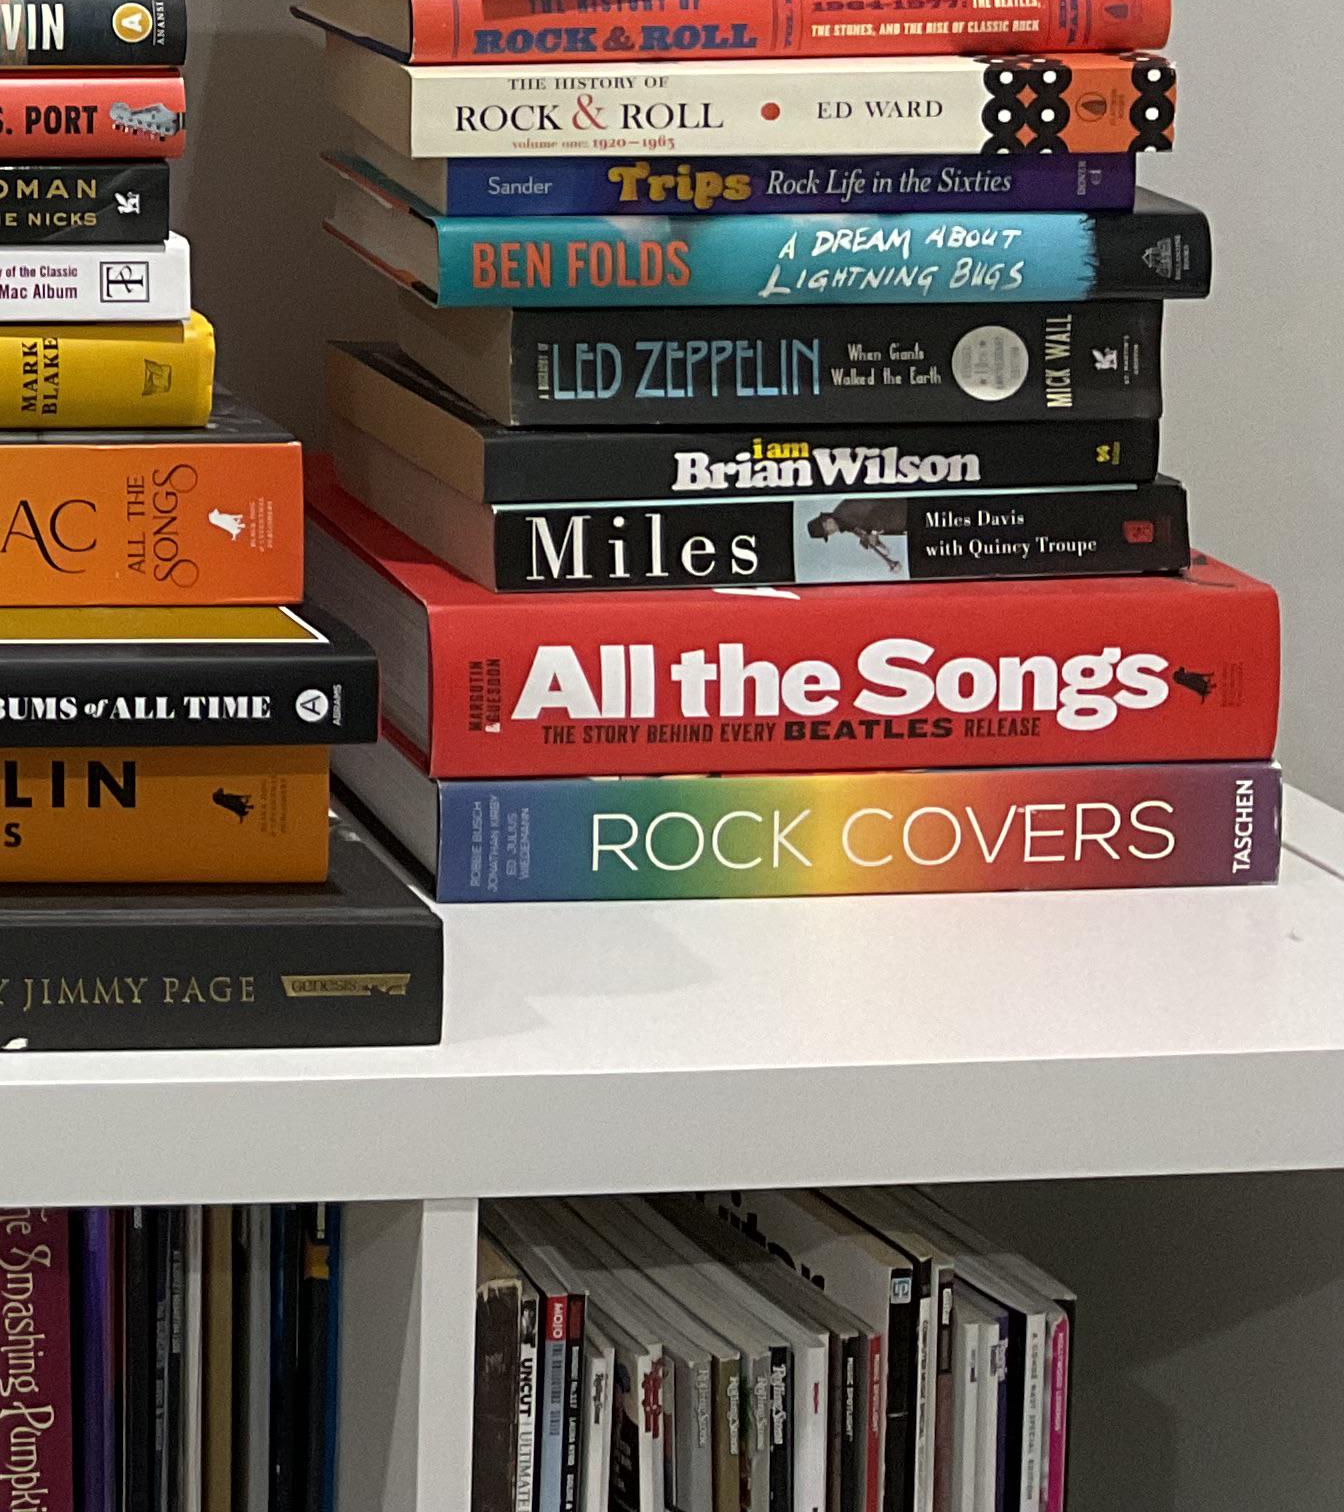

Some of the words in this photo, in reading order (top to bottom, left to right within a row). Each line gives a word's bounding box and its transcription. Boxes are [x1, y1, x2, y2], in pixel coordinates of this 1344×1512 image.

[26, 105, 98, 135] PORT
[817, 101, 853, 119] ED
[867, 99, 943, 119] WARD
[487, 178, 552, 195] Sander
[610, 164, 751, 208] Trips
[767, 169, 819, 195] Rock
[826, 168, 865, 194] Life
[872, 174, 888, 192] in
[894, 169, 930, 192] the
[937, 166, 1012, 193] Sixties
[473, 242, 558, 289] BEN
[567, 240, 691, 287] FOLDS
[925, 510, 969, 528] Miles
[978, 510, 1024, 526] Davis
[526, 515, 761, 582] Miles
[925, 541, 962, 556] with
[969, 539, 1029, 560] Quincy
[1036, 537, 1096, 556] Troupe
[513, 644, 661, 720] All
[671, 643, 839, 717] the
[858, 638, 1170, 732] Songs
[84, 700, 106, 719] of
[111, 699, 176, 720] ALL
[184, 697, 271, 719] TIME
[542, 727, 574, 744] THE
[581, 727, 638, 744] STORY
[646, 726, 712, 743] BEHIND
[721, 723, 776, 742] EVERY
[783, 718, 953, 741] BEATLES
[964, 717, 1039, 737] RELEASE
[592, 810, 812, 873] ROCK
[842, 801, 1176, 867] COVERS
[1233, 779, 1252, 873] TASCHEN
[20, 977, 147, 1011] JIMMY
[163, 977, 256, 1004] PAGE
[519, 1357, 534, 1418] UNCUT
